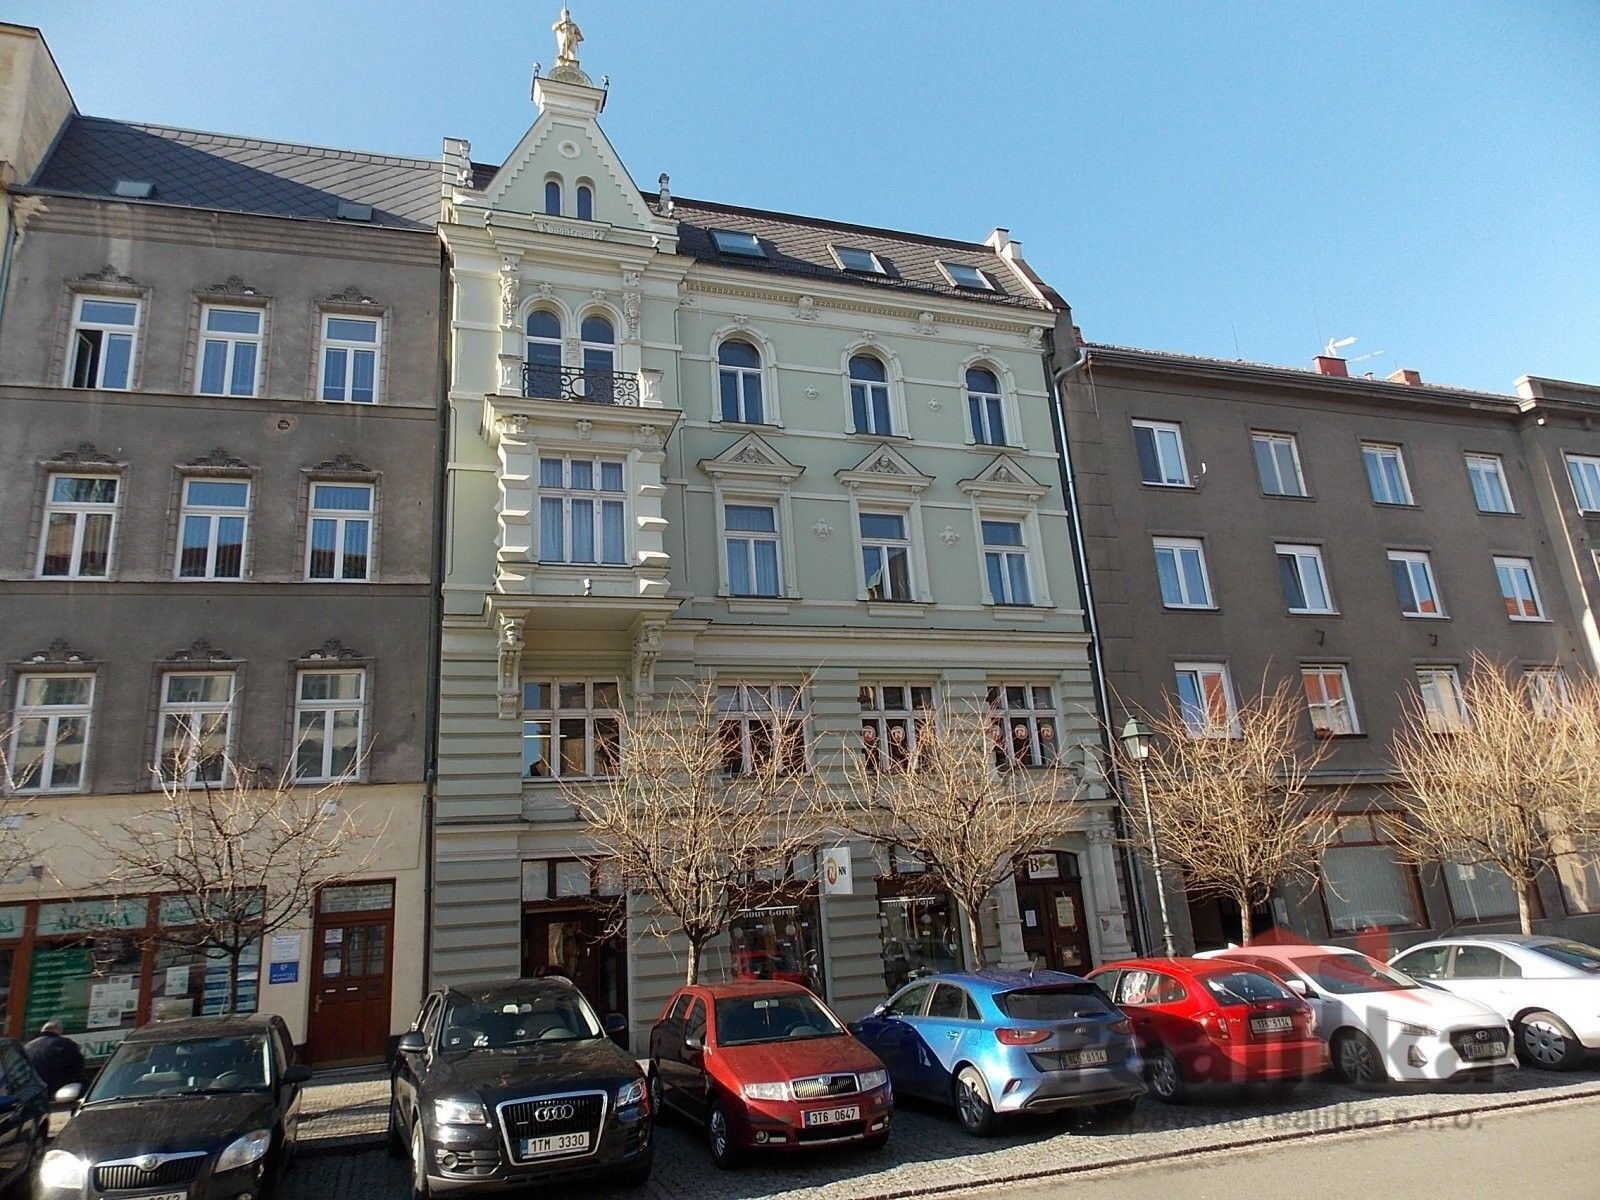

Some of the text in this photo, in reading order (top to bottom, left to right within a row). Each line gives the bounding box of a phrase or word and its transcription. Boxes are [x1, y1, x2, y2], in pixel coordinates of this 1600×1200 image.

[812, 1108, 856, 1124] 3T6 0647
[531, 1133, 585, 1152] 1TM 3330
